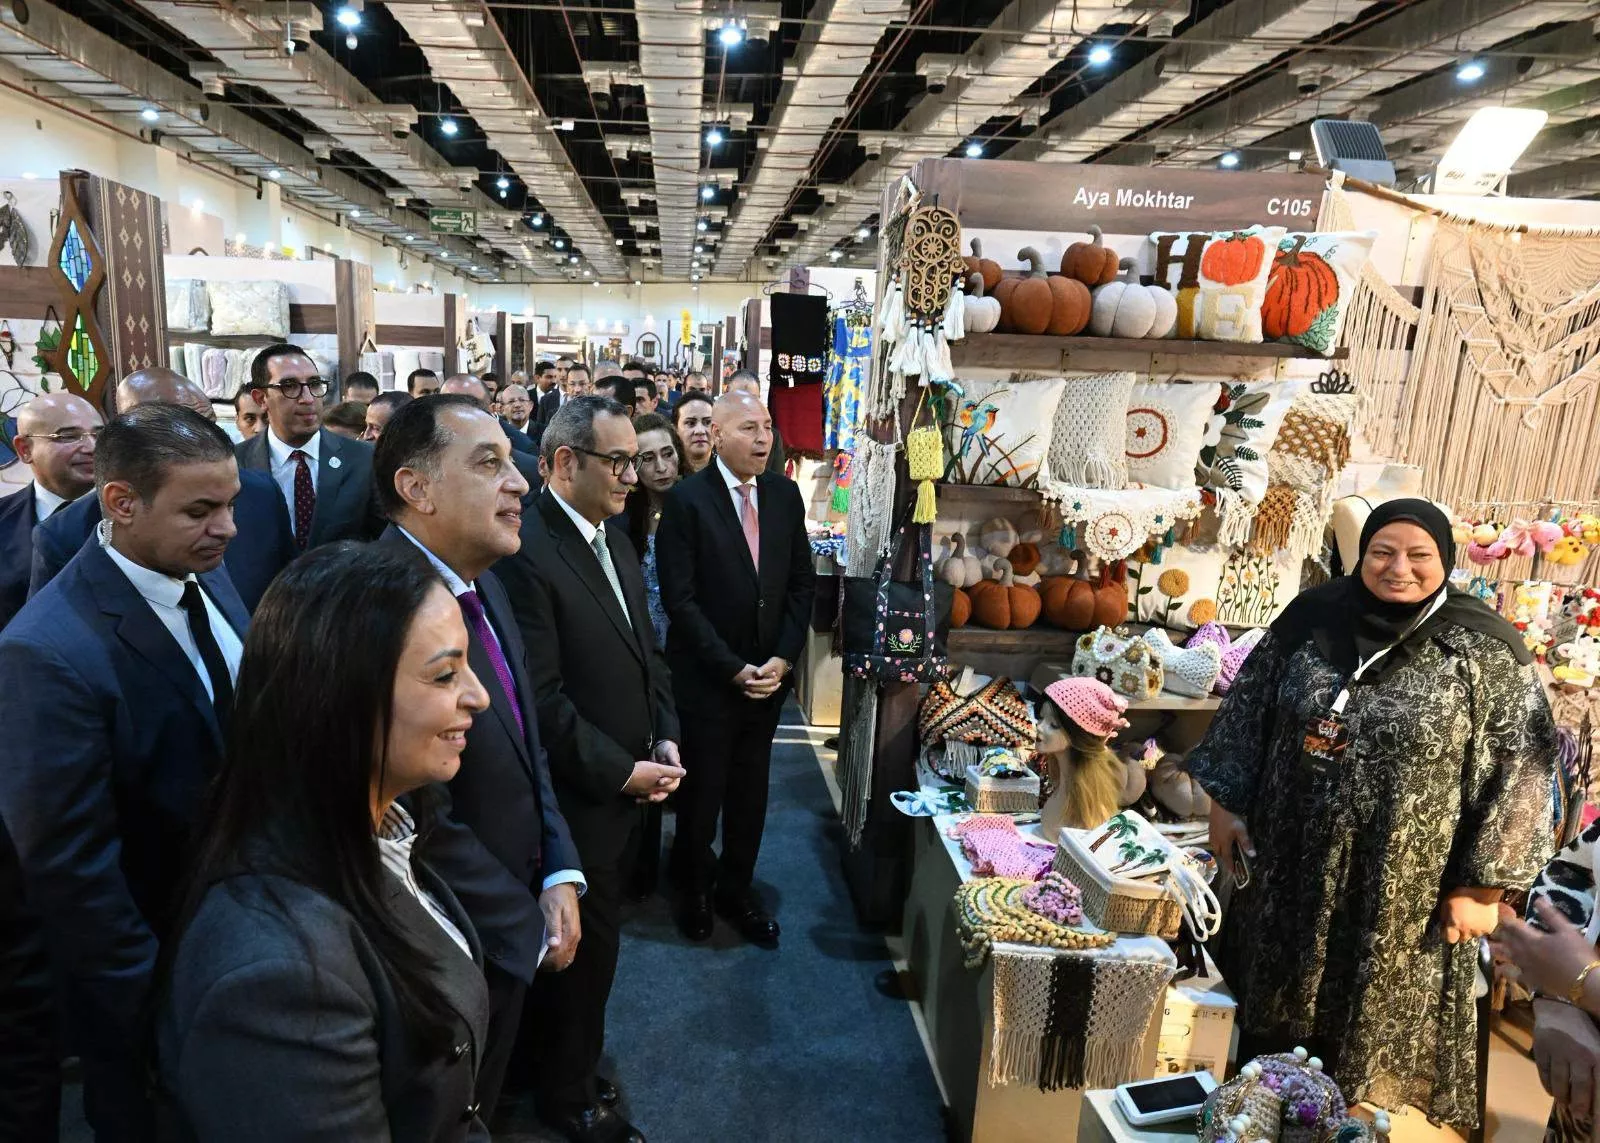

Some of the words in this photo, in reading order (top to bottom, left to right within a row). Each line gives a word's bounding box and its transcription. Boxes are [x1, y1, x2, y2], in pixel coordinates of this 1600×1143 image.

[1072, 186, 1110, 210] Aya
[1115, 188, 1195, 210] Mokhtar
[1266, 198, 1313, 217] C105
